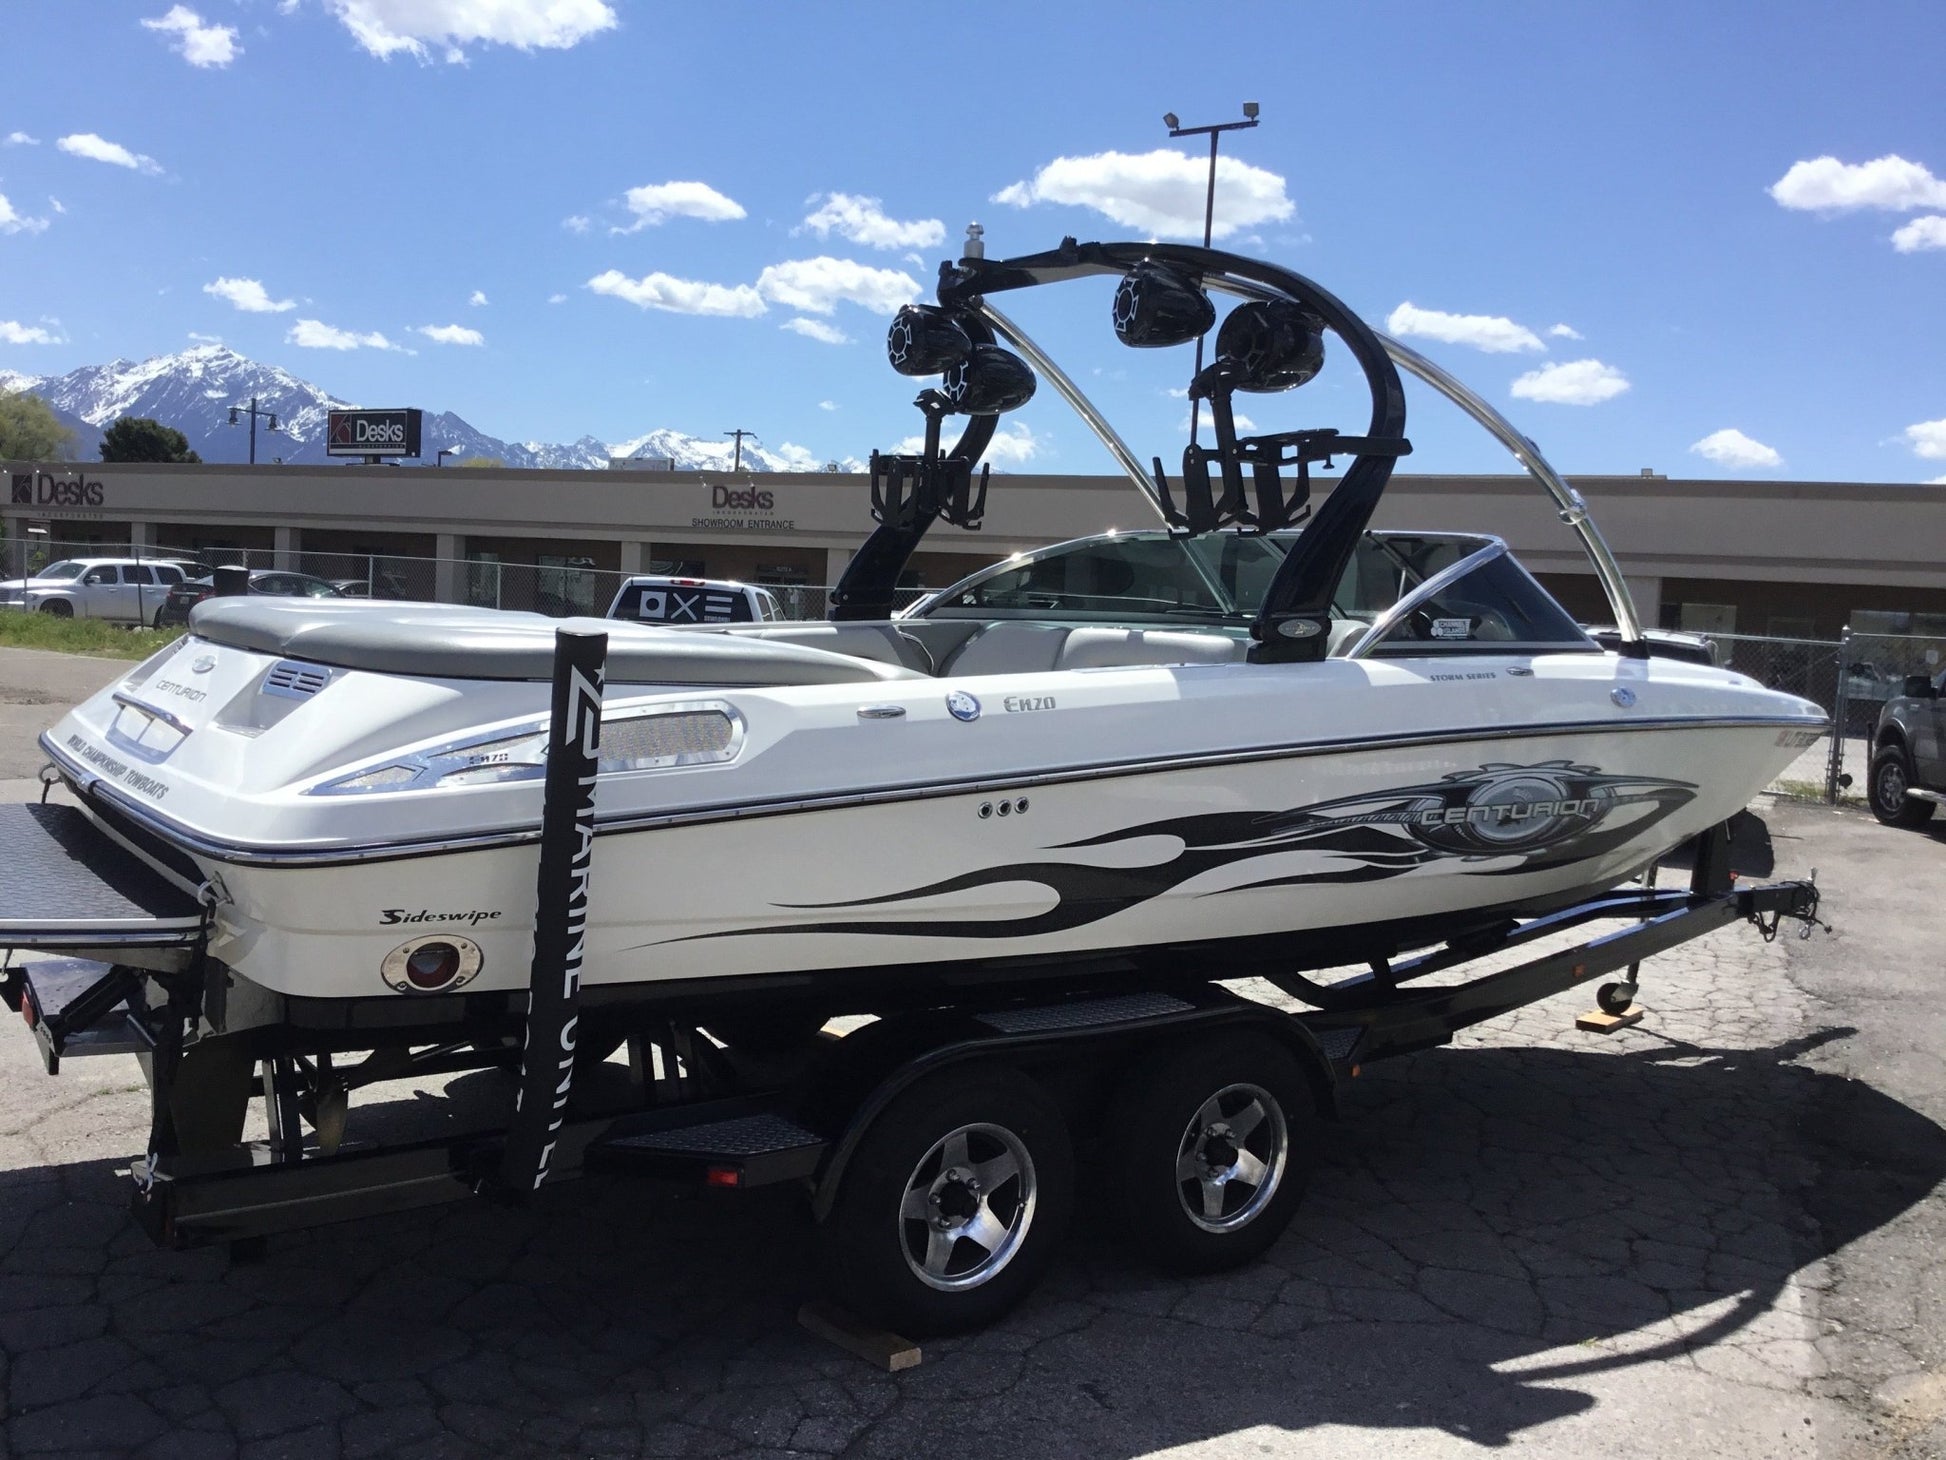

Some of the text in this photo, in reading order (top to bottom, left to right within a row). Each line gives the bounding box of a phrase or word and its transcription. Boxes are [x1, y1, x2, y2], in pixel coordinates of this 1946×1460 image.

[356, 419, 404, 442] Desks
[37, 473, 104, 506] Desks
[712, 486, 774, 510] Desks
[691, 518, 795, 530] SHOWROOM ENTRANCE
[1430, 672, 1497, 682] STORM SERIES
[67, 734, 169, 800] WORLD CHAMPIONSHIP TOWBOATS
[1420, 799, 1599, 828] CENTURION
[379, 909, 502, 926] Sideswipe
